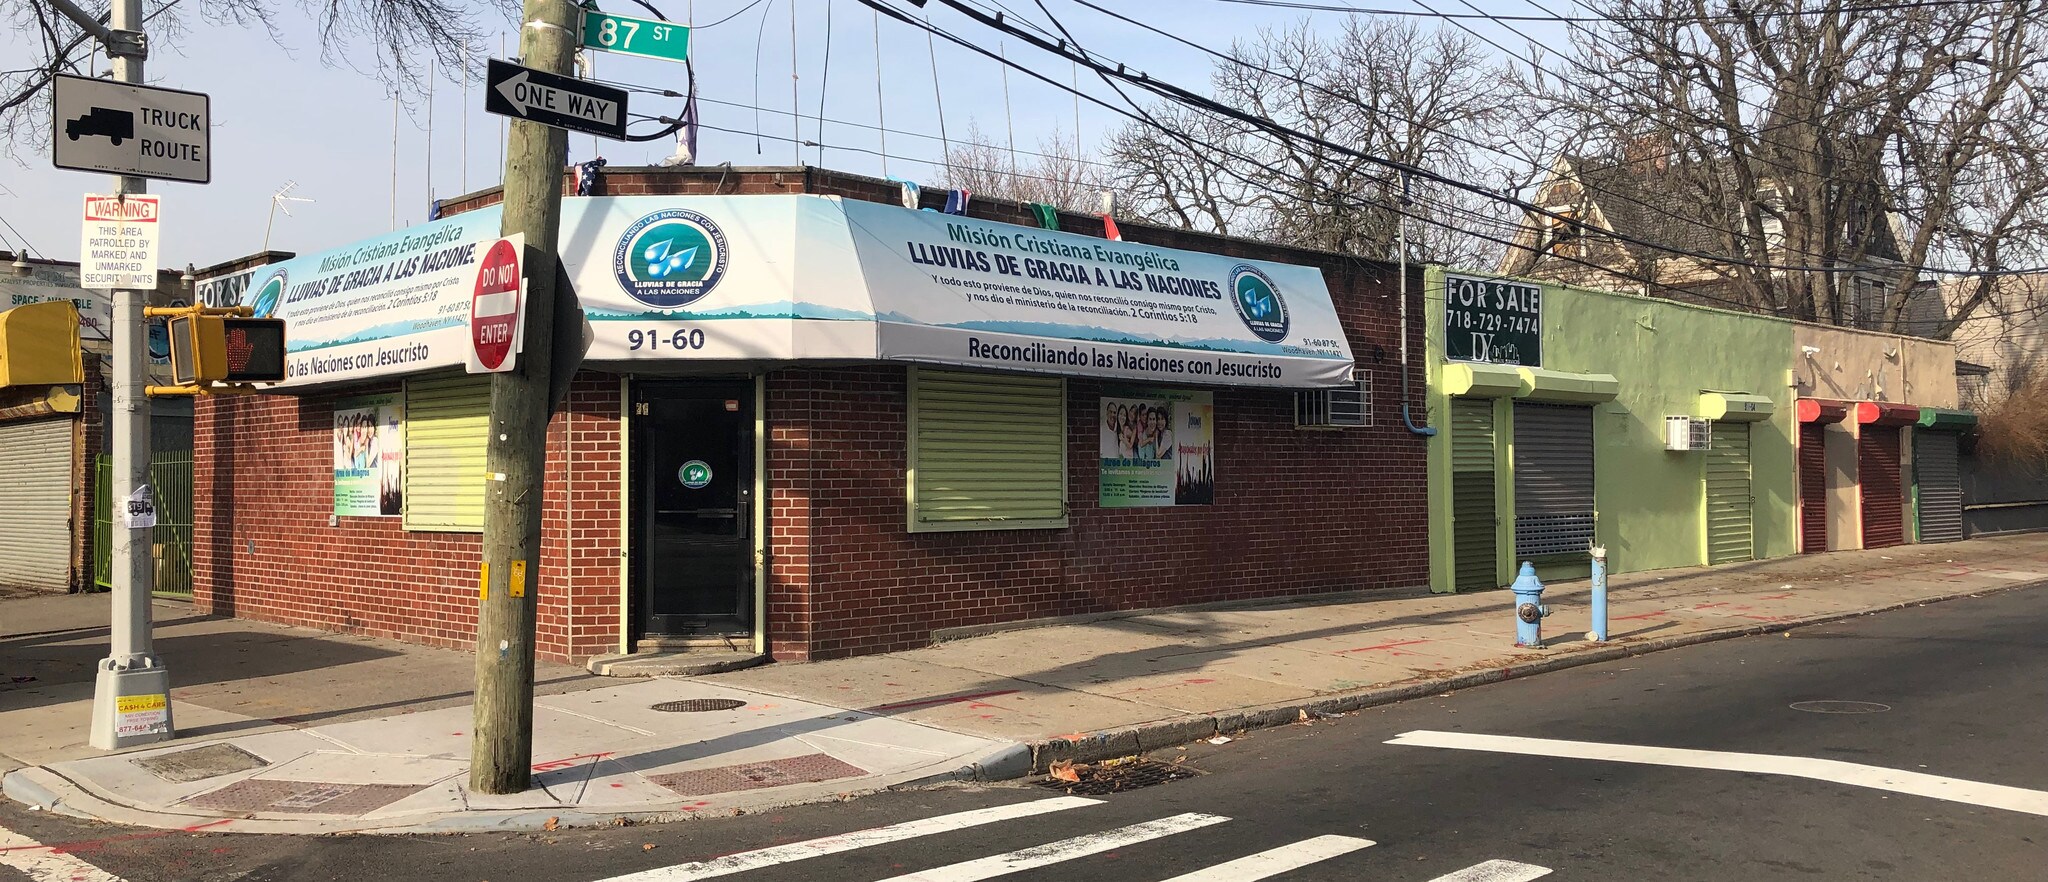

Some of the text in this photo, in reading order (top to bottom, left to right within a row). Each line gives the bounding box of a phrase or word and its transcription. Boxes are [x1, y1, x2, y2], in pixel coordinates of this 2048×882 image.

[598, 18, 672, 49] 87 ST
[514, 82, 609, 120] ONE WAY
[140, 108, 200, 131] TRUCK
[141, 138, 200, 162] ROUTE
[94, 202, 150, 217] WARNING
[90, 238, 150, 248] PATROLLED BY
[98, 227, 142, 236] THIS AREA
[615, 211, 726, 274] RECONCILIANDO LAS NACIONES CON JESUCRISTO
[92, 250, 147, 259] MARKED AND
[318, 224, 463, 274] Misión Cristiana Evangélica
[947, 223, 1180, 271] Misión Cristiana Evangélica
[96, 262, 142, 271] UNMARKED
[483, 264, 514, 287] DO NOT
[907, 241, 991, 272] LLUVIAS
[994, 254, 1022, 276] DE
[1024, 258, 1092, 285] GRACIA
[1095, 267, 1109, 287] A
[1110, 269, 1143, 291] LAS
[1144, 273, 1222, 300] NACIONES
[286, 278, 329, 303] LLUVIAS
[327, 274, 345, 295] DE
[342, 264, 384, 292] GRACIA
[382, 262, 395, 282] A
[394, 256, 420, 280] LAS
[198, 282, 223, 308] FOR
[387, 300, 393, 309] 2
[393, 295, 421, 308] Corintios
[422, 290, 438, 303] 5:18
[455, 302, 464, 311] 87
[932, 274, 938, 283] Y
[940, 276, 961, 286] todo
[963, 280, 981, 288] esto
[983, 282, 1020, 293] proviene
[1022, 286, 1032, 294] de
[1033, 287, 1054, 298] Dios,
[1055, 291, 1077, 300] quien
[1093, 296, 1129, 305] reconcilió
[1130, 299, 1158, 311] consigo
[1159, 302, 1181, 311] mismo
[1196, 305, 1217, 315] Cristo,
[1448, 279, 1538, 313] FOR SALE
[966, 293, 972, 302] y
[974, 293, 989, 302] nos
[1006, 296, 1014, 304] el
[1015, 297, 1056, 309] ministerio
[1057, 301, 1067, 310] de
[1068, 302, 1076, 312] la
[1077, 305, 1130, 317] reconciliación.
[1131, 308, 1137, 317] 2
[1138, 309, 1178, 322] Corintios
[1179, 312, 1198, 323] 5:18
[480, 323, 508, 344] ENTER
[1447, 310, 1538, 335] 718-729-7474
[628, 328, 705, 350] 91-60
[1303, 338, 1322, 346] 91-60
[296, 358, 308, 376] las
[310, 354, 354, 375] Naciones
[356, 353, 373, 369] con
[375, 342, 429, 366] Jesucristo
[969, 337, 1282, 378] Reconciliando las Naciones con Jesucristo
[1132, 458, 1160, 469] Milagros
